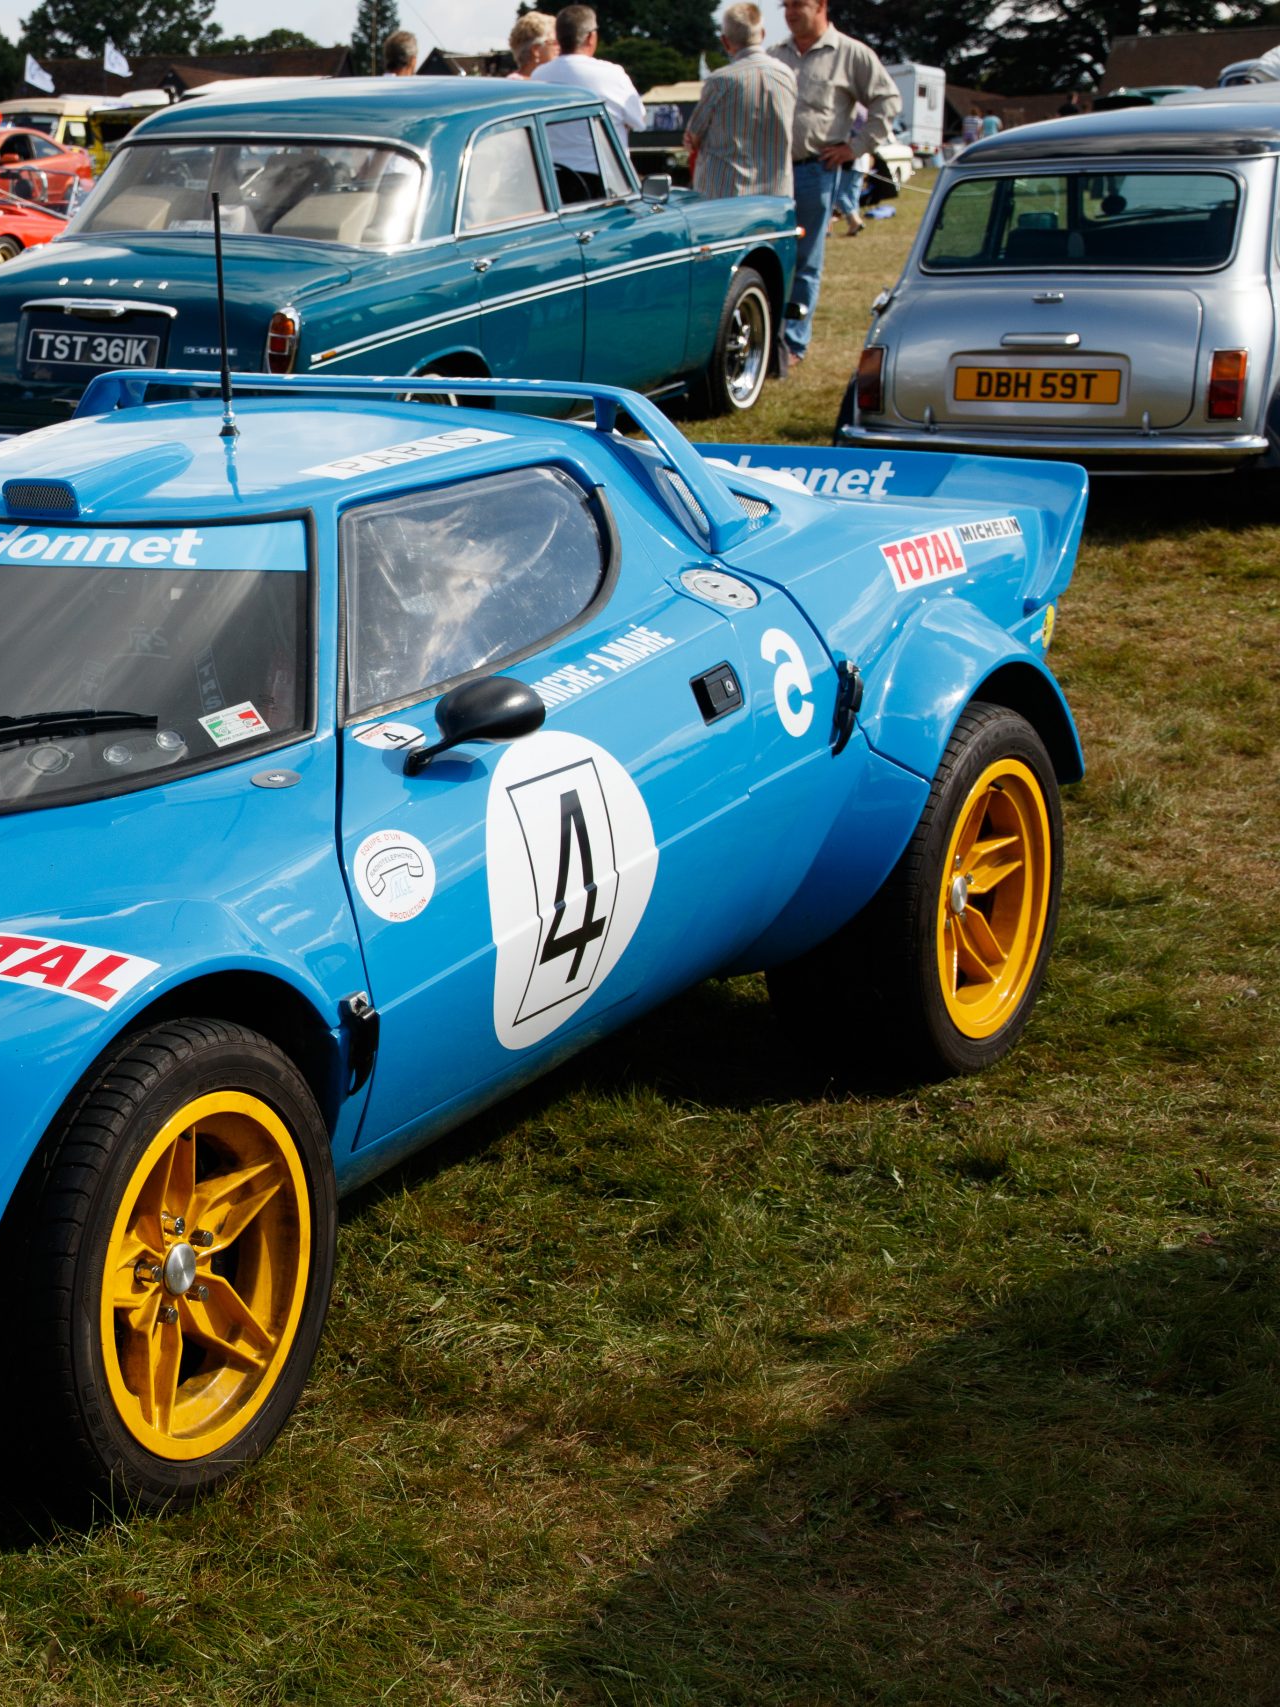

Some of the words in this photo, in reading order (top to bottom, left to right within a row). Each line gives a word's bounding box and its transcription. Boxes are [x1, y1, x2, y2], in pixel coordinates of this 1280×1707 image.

[38, 334, 88, 361] TST
[90, 337, 149, 365] 361K
[976, 371, 1031, 398] DBH
[1039, 373, 1098, 399] 59T
[327, 430, 483, 473] PARIS
[959, 518, 1021, 542] MICHELIN
[883, 531, 964, 585] TOTAL
[383, 732, 408, 742] 4
[539, 789, 607, 984] 4
[390, 897, 427, 919] PRODUCTION
